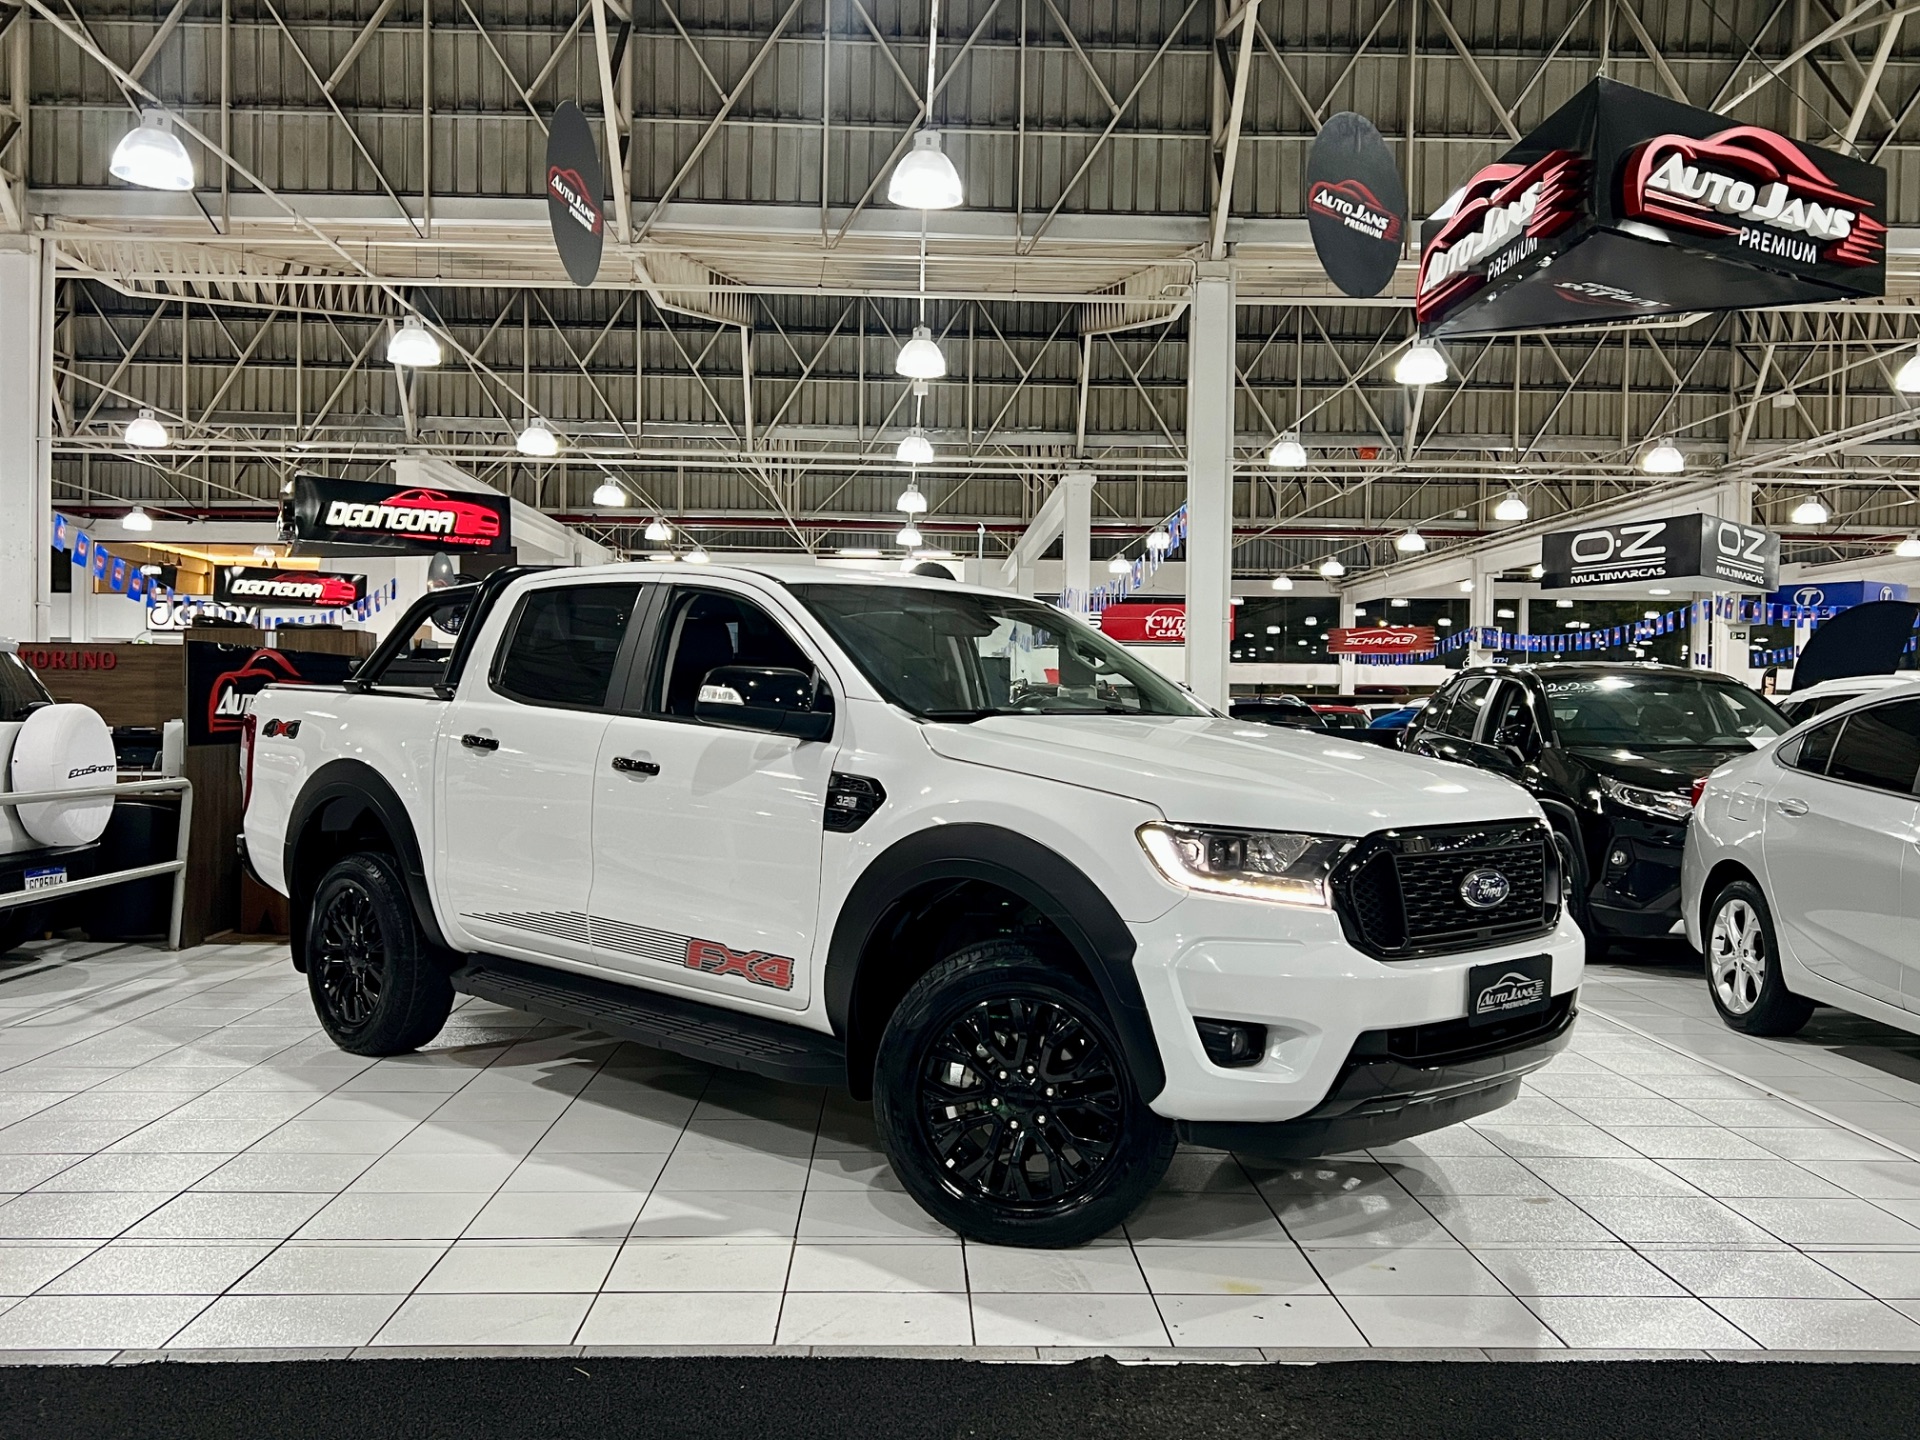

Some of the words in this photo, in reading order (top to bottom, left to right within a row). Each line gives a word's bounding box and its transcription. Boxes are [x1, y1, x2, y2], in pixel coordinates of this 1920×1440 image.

[1344, 216, 1383, 240] PREMIUM
[1738, 226, 1817, 265] PREMIUM
[1486, 236, 1539, 283] PREMIUM
[1570, 566, 1667, 585] MULTIMARCAS
[1716, 564, 1765, 585] MULTIMARCAS
[1344, 636, 1413, 646] SCHAFAS
[685, 938, 794, 990] FX4
